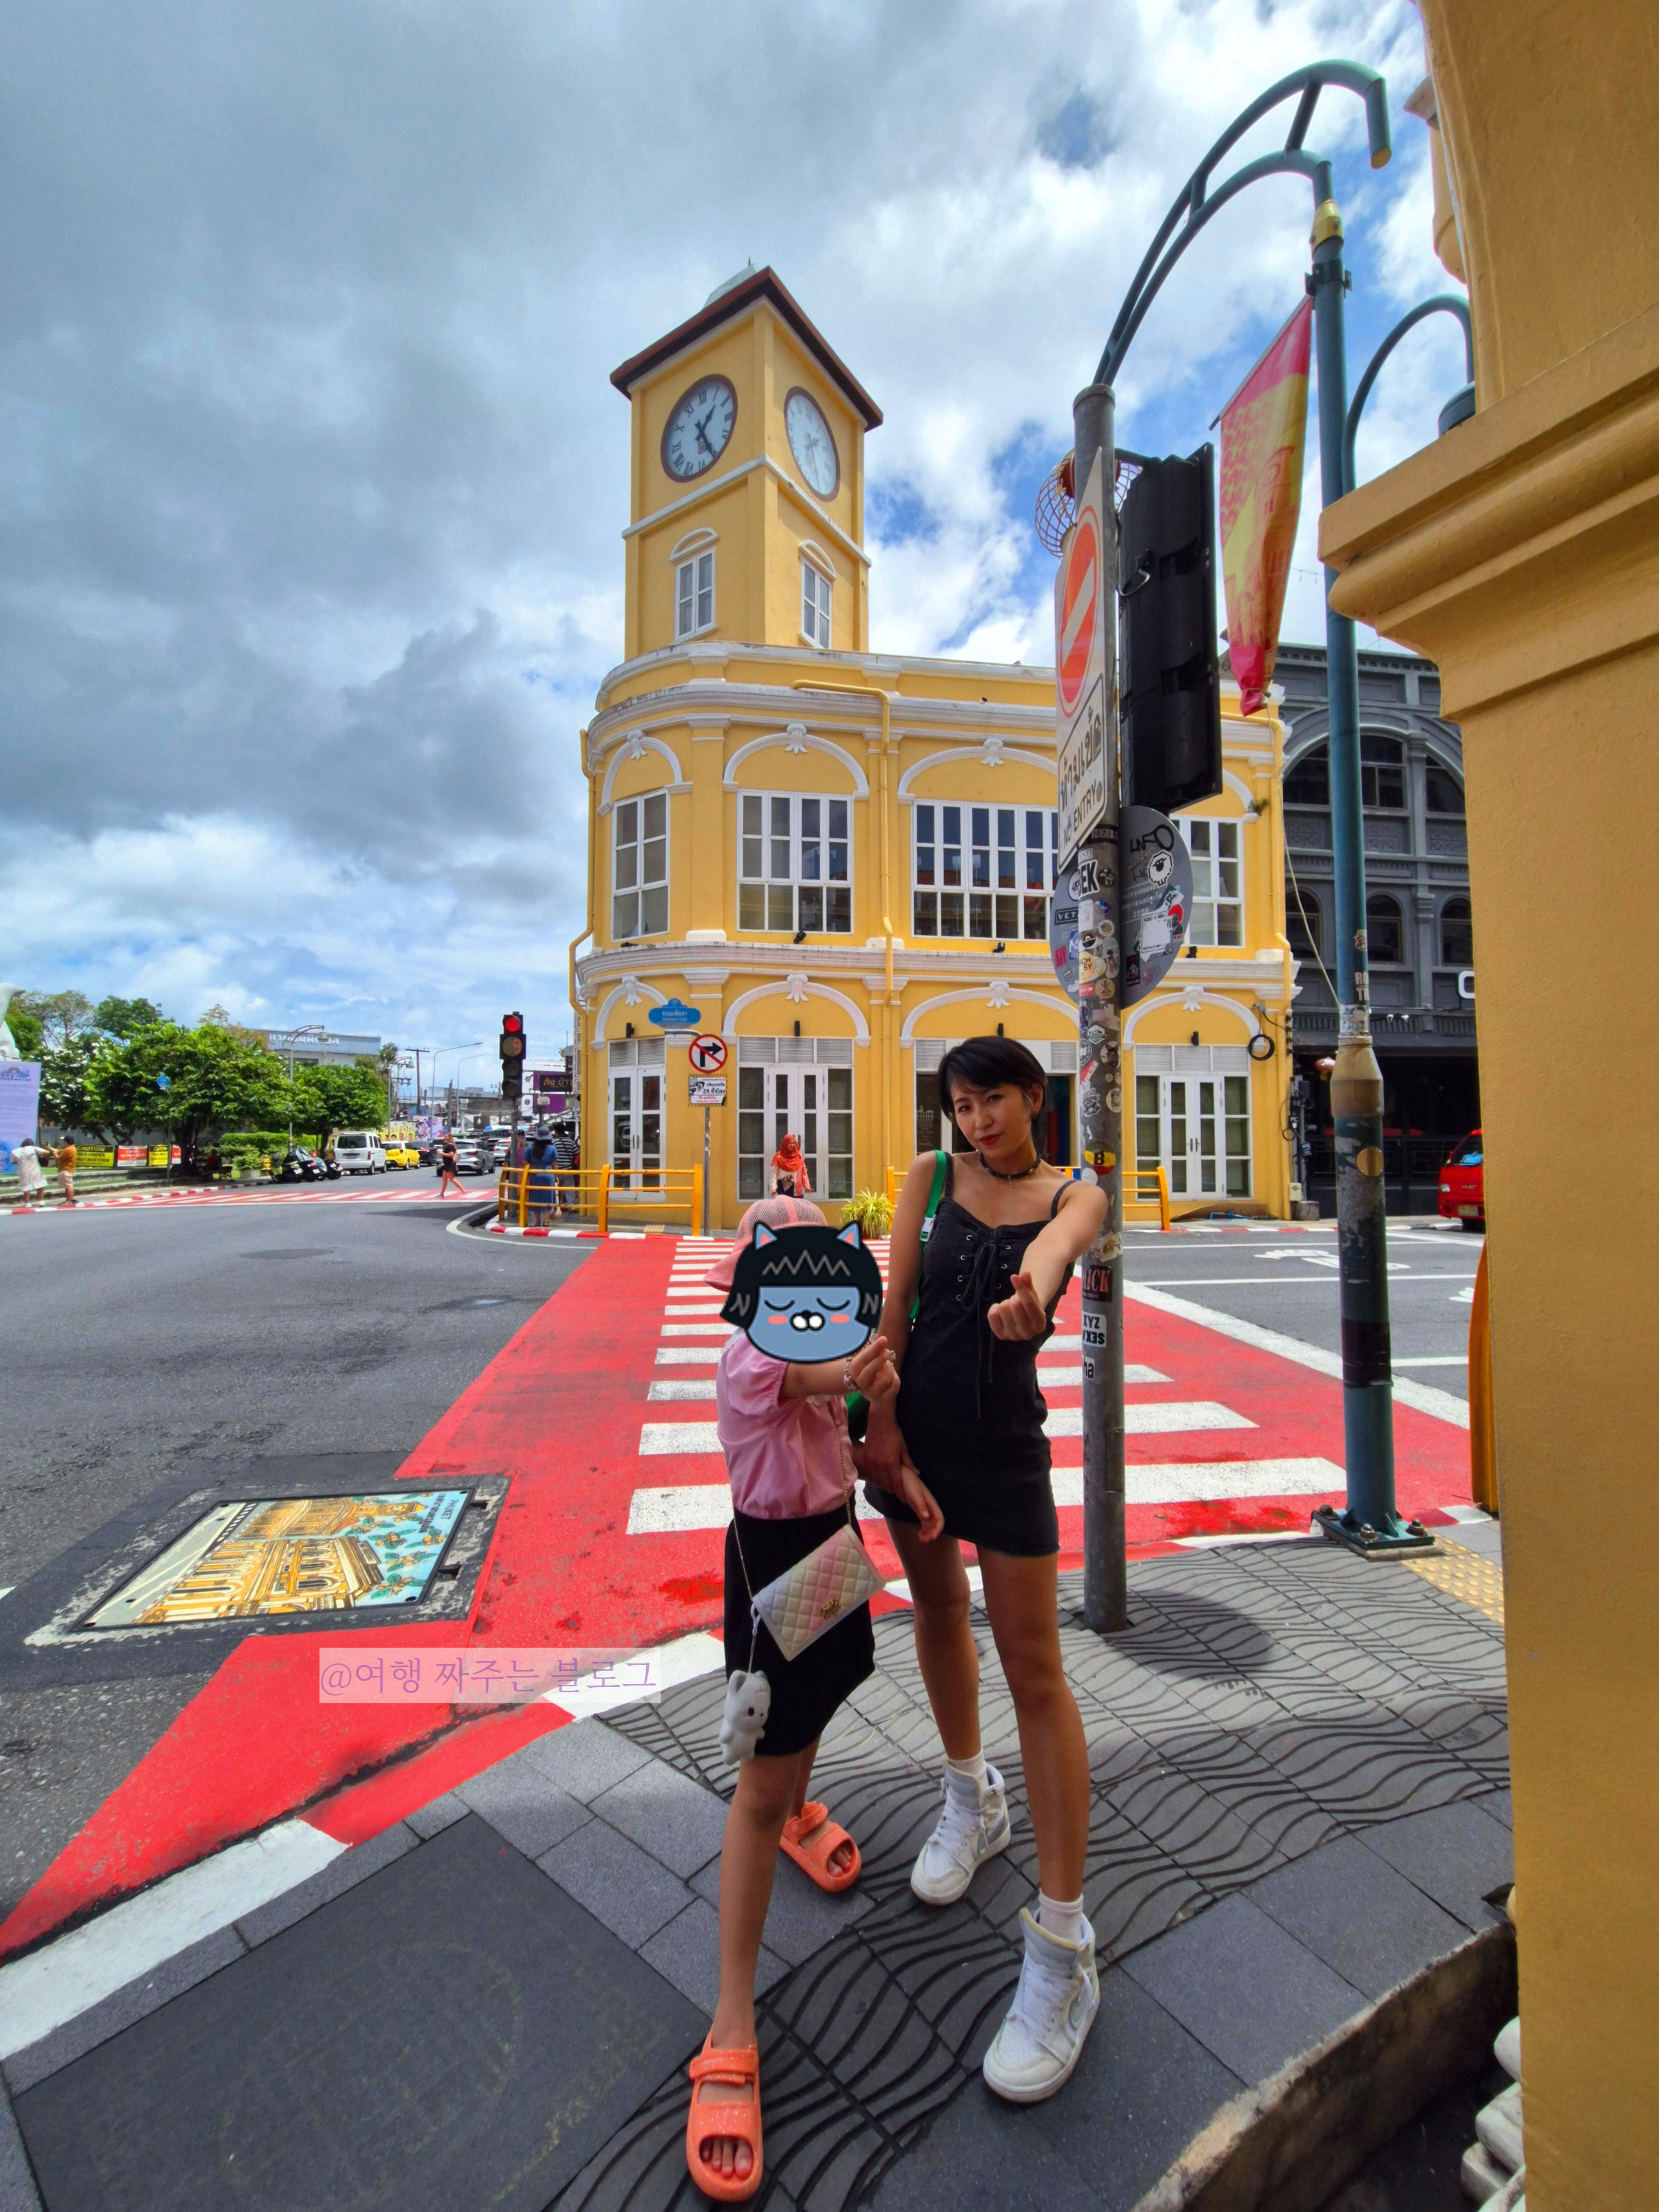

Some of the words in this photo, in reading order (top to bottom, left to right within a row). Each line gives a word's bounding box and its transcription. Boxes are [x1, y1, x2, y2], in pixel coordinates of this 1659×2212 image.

[1064, 821, 1072, 849] NO
[1074, 779, 1097, 832] ENTRY
[1094, 1152, 1105, 1165] B
[440, 1499, 459, 1520] PHUKET
